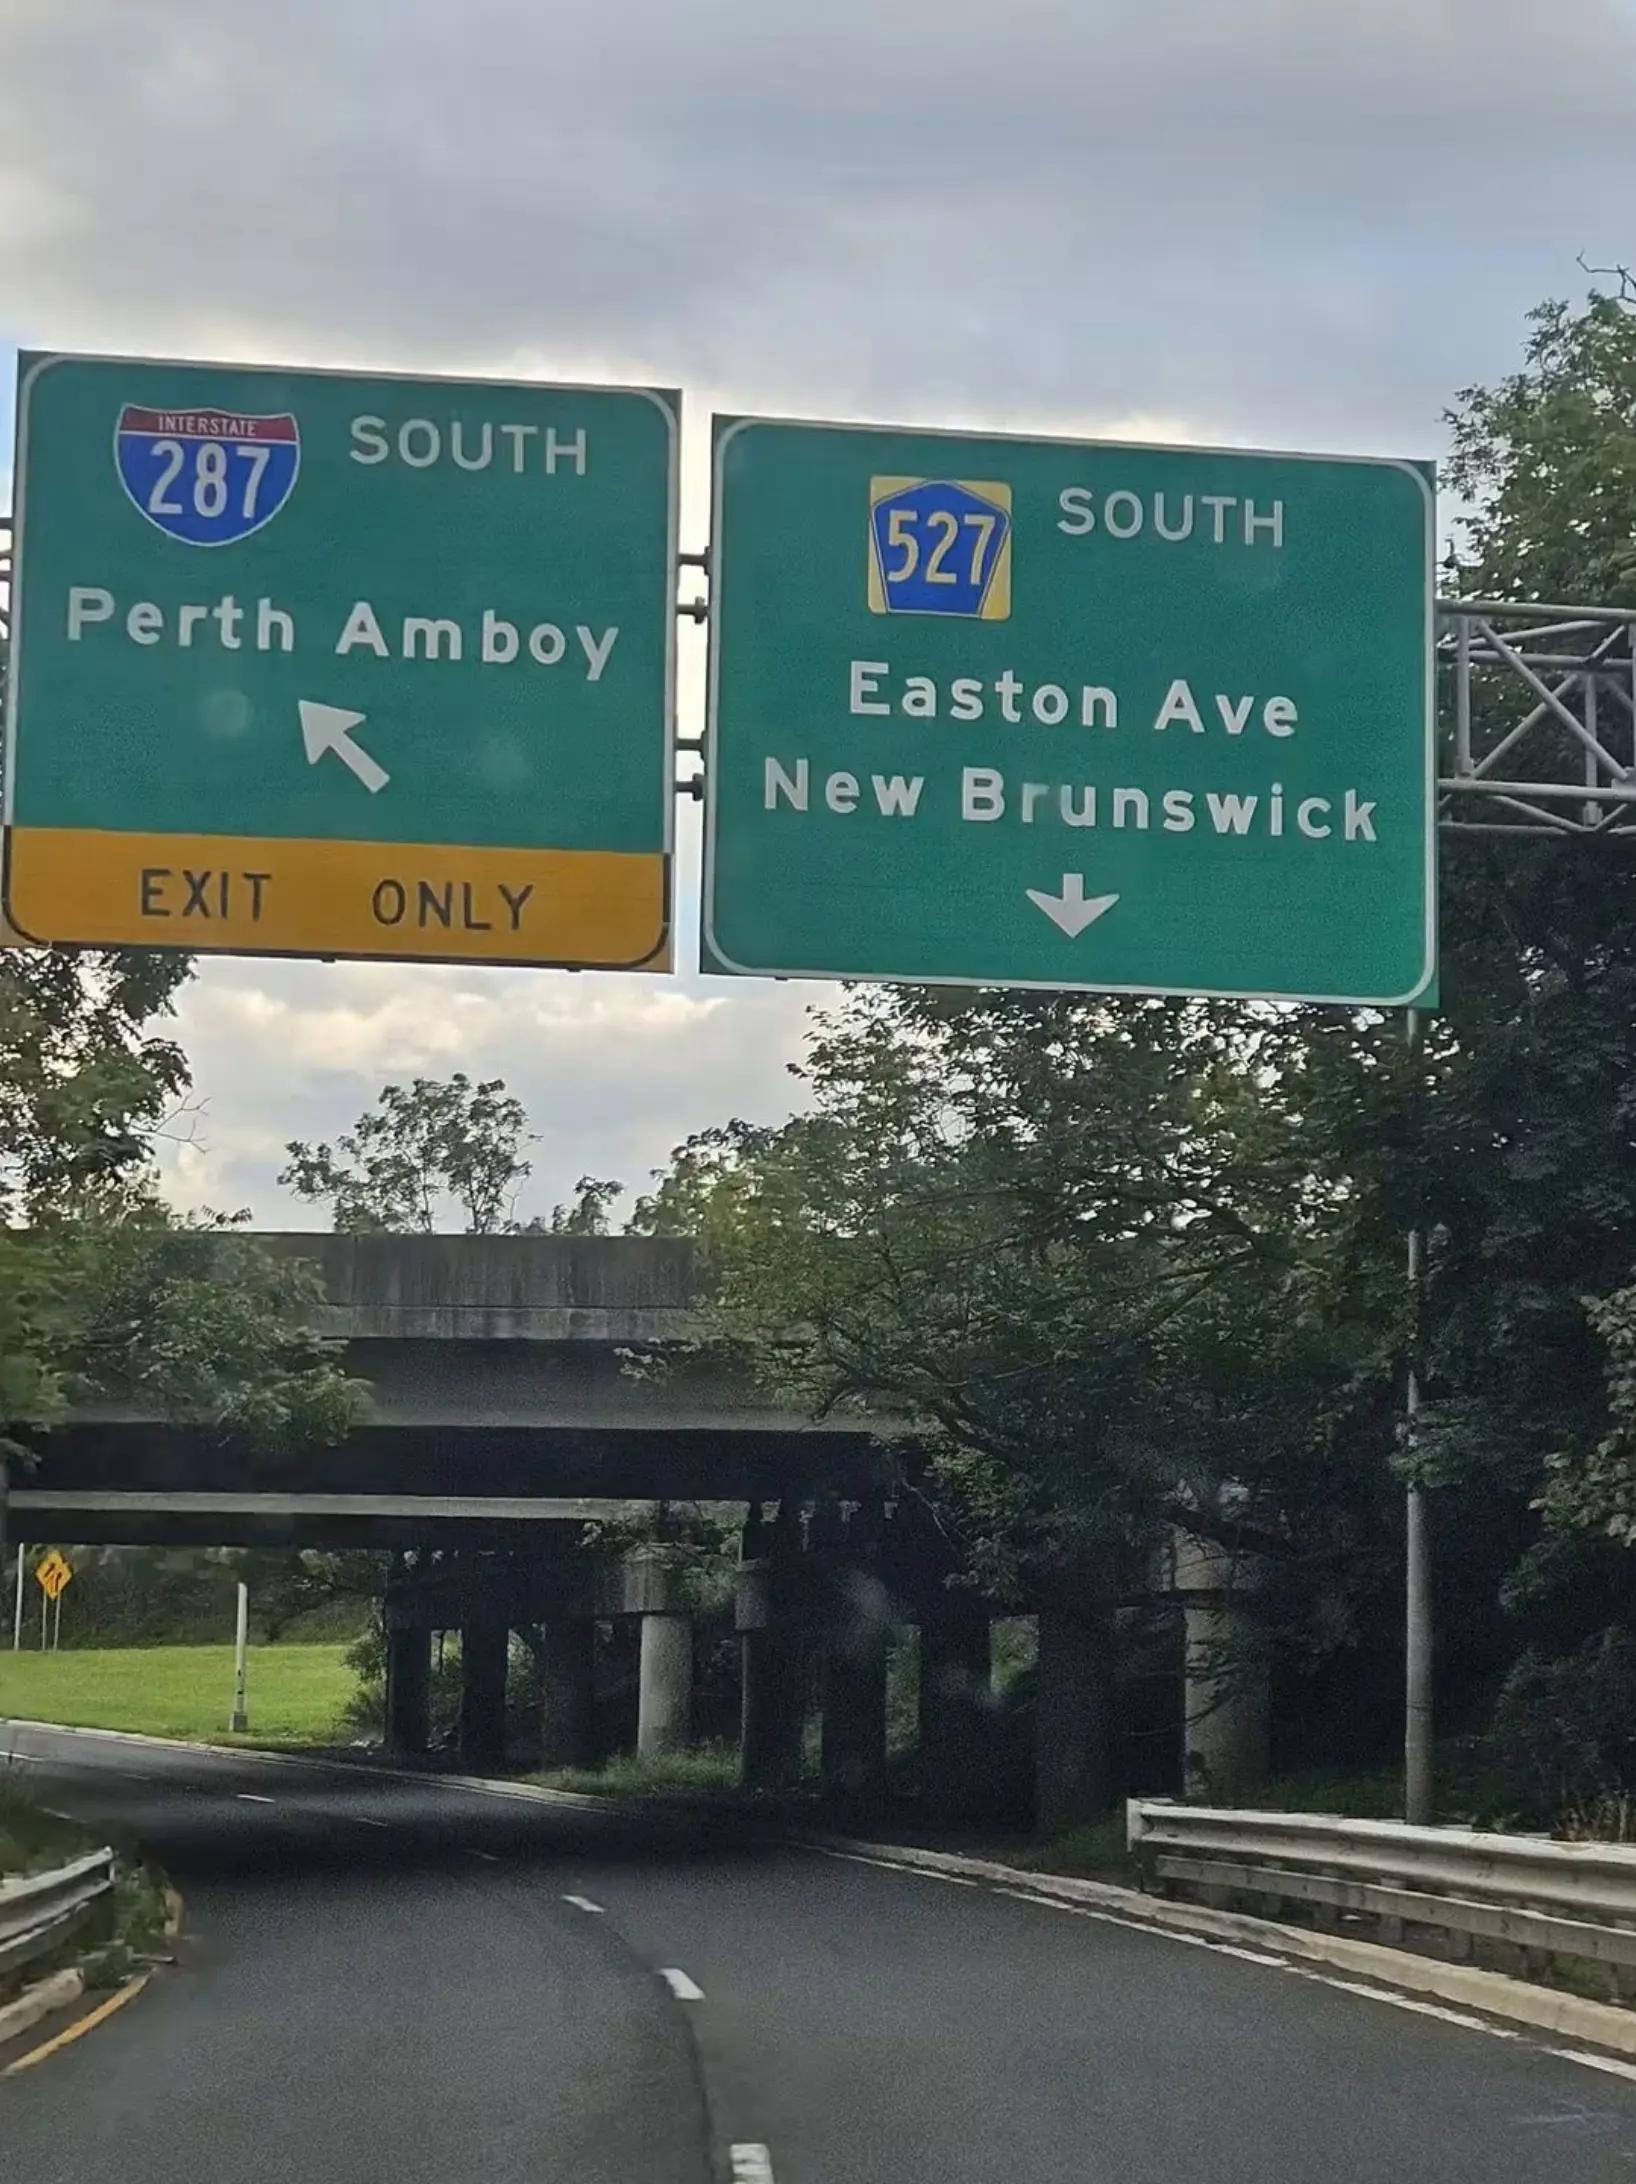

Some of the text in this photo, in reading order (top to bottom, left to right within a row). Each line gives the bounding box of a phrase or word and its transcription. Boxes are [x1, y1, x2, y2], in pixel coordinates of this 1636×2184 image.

[158, 415, 257, 436] INTERSTATE
[350, 415, 587, 476] SOUTH
[149, 440, 271, 519] 287
[1057, 487, 1284, 547] SOUTH
[887, 510, 996, 587] 527
[67, 587, 618, 680] Perth Amboy
[849, 660, 1299, 737] Easton Ave
[764, 757, 1377, 841] New Brunswick
[141, 868, 533, 931] EXIT ONLY
